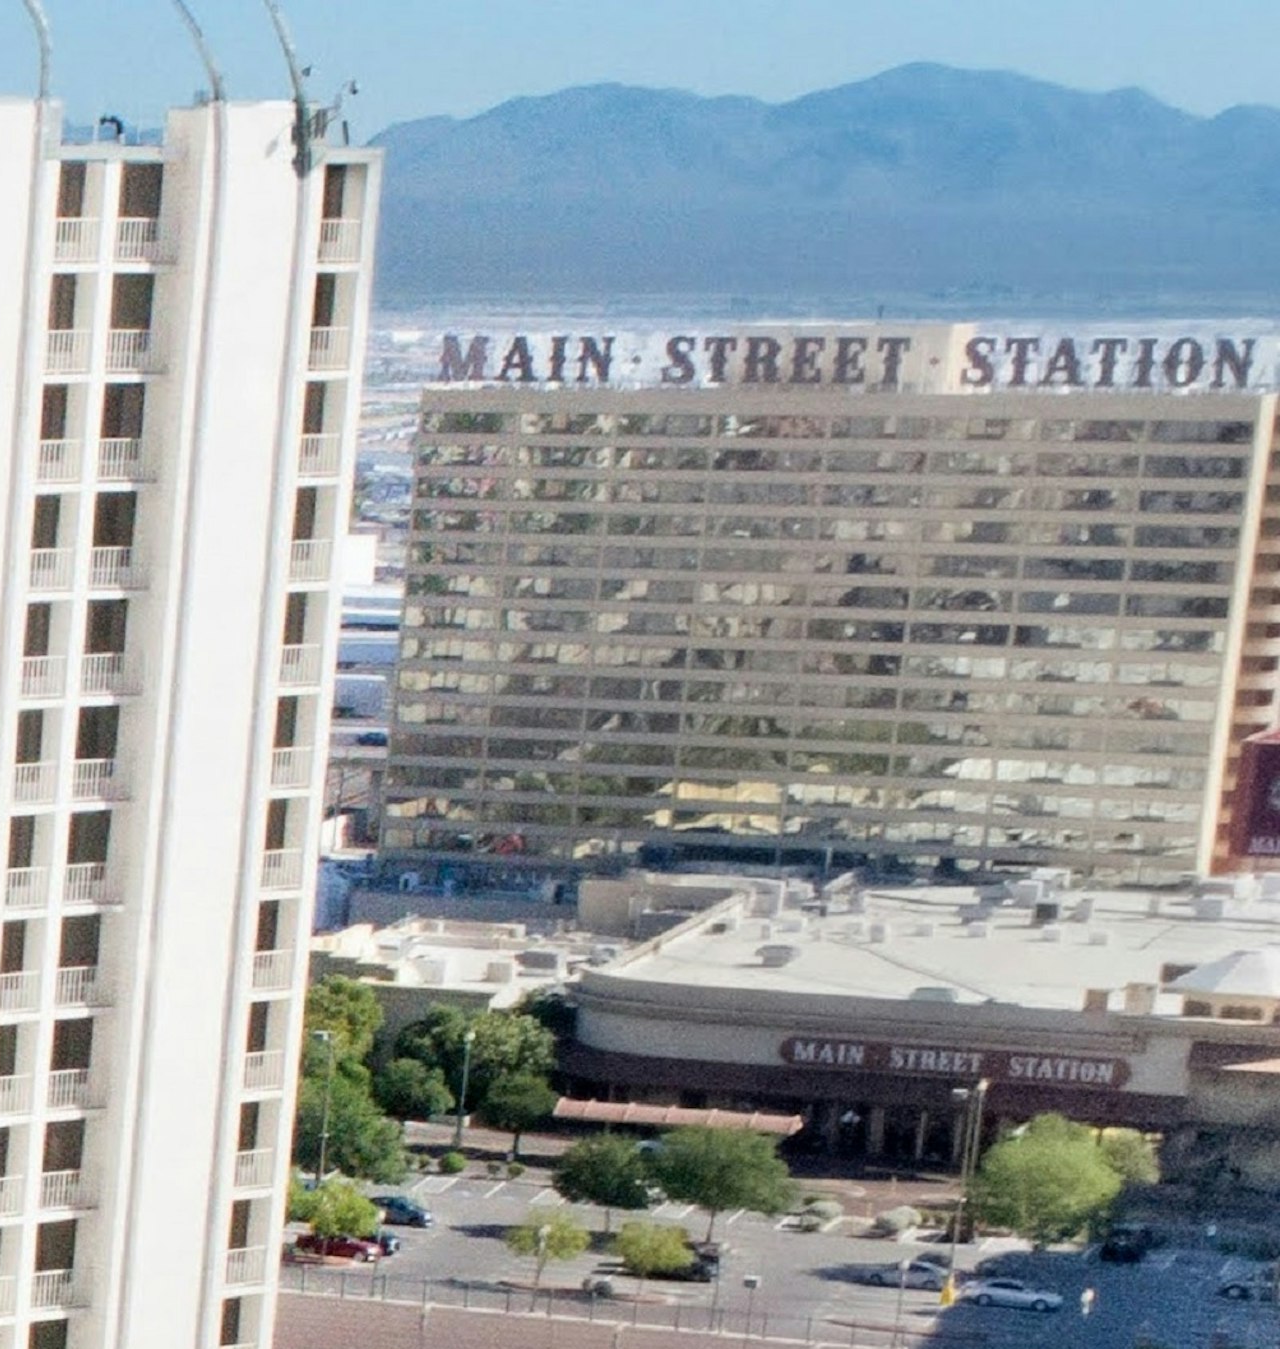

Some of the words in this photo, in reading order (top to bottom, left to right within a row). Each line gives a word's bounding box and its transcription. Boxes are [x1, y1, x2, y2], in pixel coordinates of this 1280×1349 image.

[438, 334, 616, 382] MAIN
[660, 335, 912, 385] STREET
[960, 336, 1257, 388] STATION
[793, 1040, 866, 1065] MAIN
[890, 1046, 985, 1073] STREET
[1008, 1055, 1116, 1083] STATION
